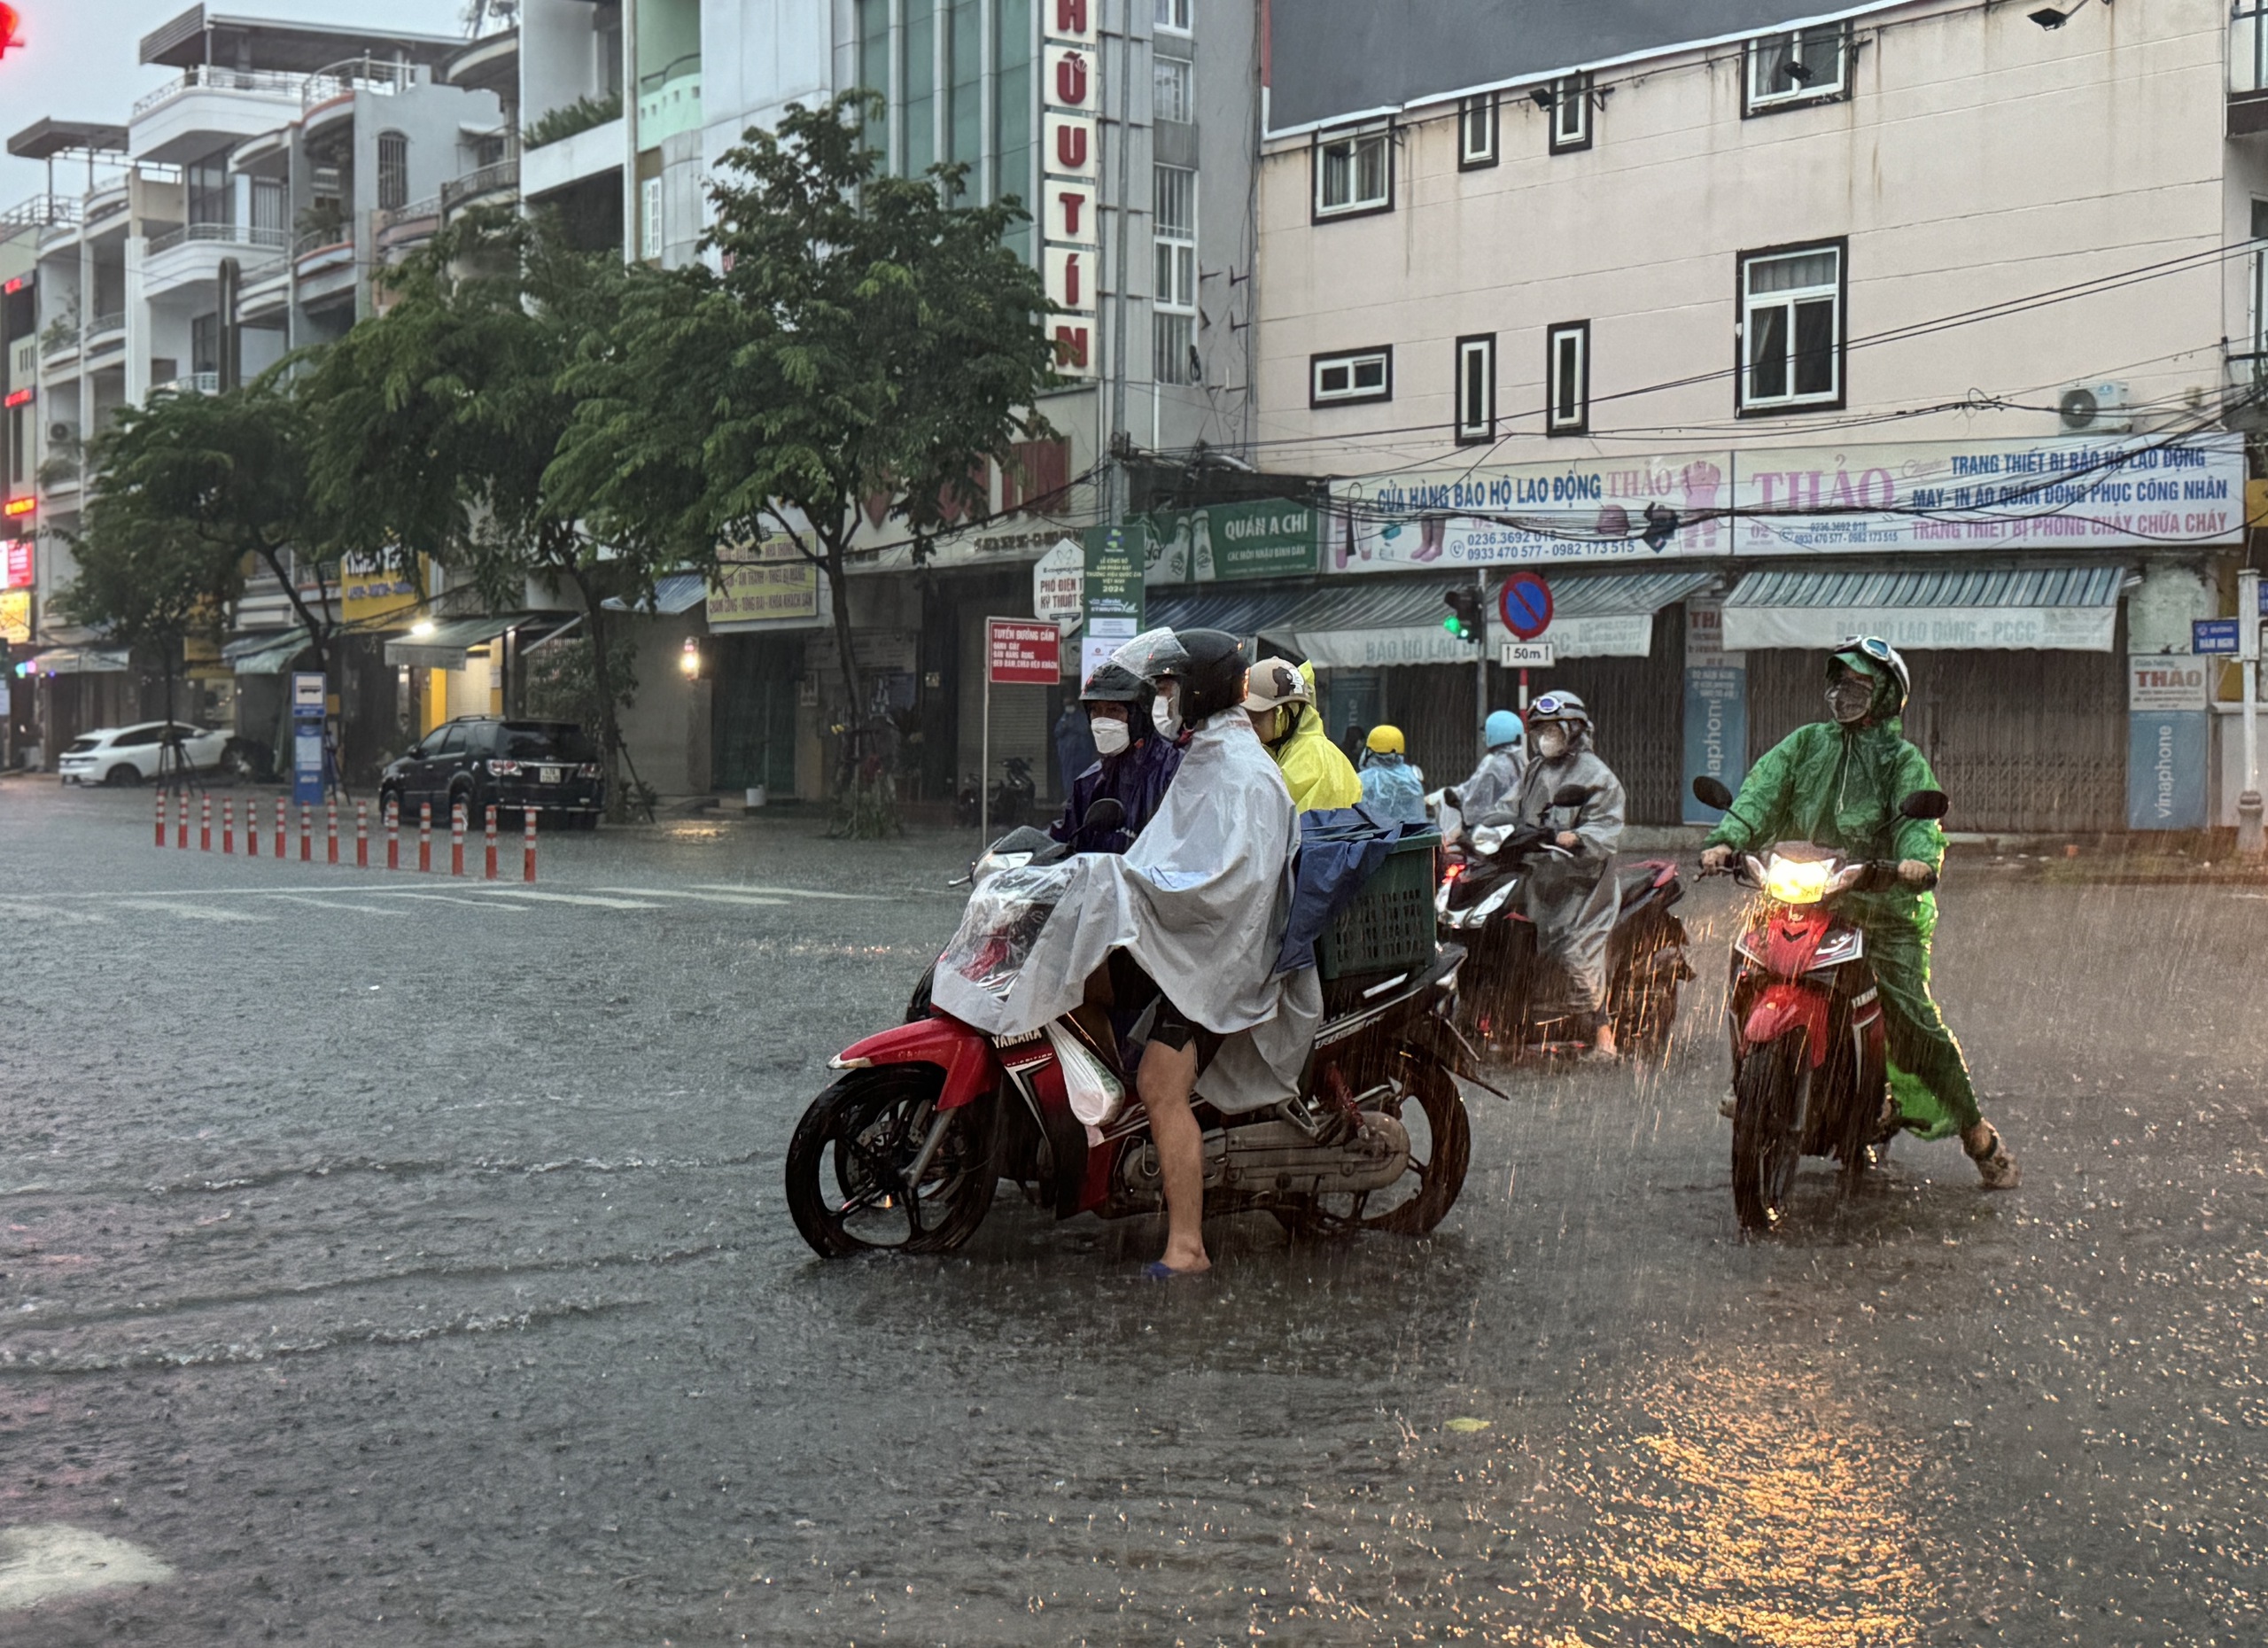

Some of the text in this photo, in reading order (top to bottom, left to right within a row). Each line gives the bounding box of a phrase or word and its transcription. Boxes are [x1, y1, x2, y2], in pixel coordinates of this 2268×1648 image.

[1952, 455, 2000, 475] TRANG
[2004, 447, 2046, 472] THIẾT
[2130, 449, 2158, 470] LAO
[2163, 447, 2206, 472] ĐỘNG
[1410, 479, 1449, 510] HÀNG
[1454, 473, 1485, 508] BẢO
[1490, 475, 1511, 510] HỘ
[1518, 477, 1548, 503] LAO
[1554, 470, 1602, 509] ĐỘNG
[1607, 461, 1673, 498] THẢO
[1751, 454, 1895, 513] THẢO
[1955, 488, 1971, 506] IN
[2091, 482, 2132, 506] PHỤC
[2137, 478, 2179, 501] CÔNG
[2184, 476, 2227, 501] NHÂN
[1225, 509, 1308, 540] QUÁN A CHÍ
[1913, 520, 1961, 540] TRANG
[1968, 515, 2007, 539] THIẾT
[2012, 517, 2028, 541] BỊ
[2091, 510, 2132, 536] CHÁY
[2138, 509, 2180, 534] CHỮA
[2186, 508, 2227, 533] CHÁY
[1467, 532, 1531, 547] 0236.3692
[1467, 548, 1495, 561] 0933
[1497, 546, 1518, 559] 470
[1520, 544, 1542, 558] 577
[1552, 543, 1581, 556] 0982
[1587, 542, 1608, 555] 173
[1612, 540, 1635, 554] 515
[994, 626, 1055, 642] TUYẾN ĐƯỜNG CẤM
[1513, 648, 1542, 659] 50m
[2154, 725, 2175, 819] vinaphone
[991, 1028, 1043, 1049] YAMAHA
